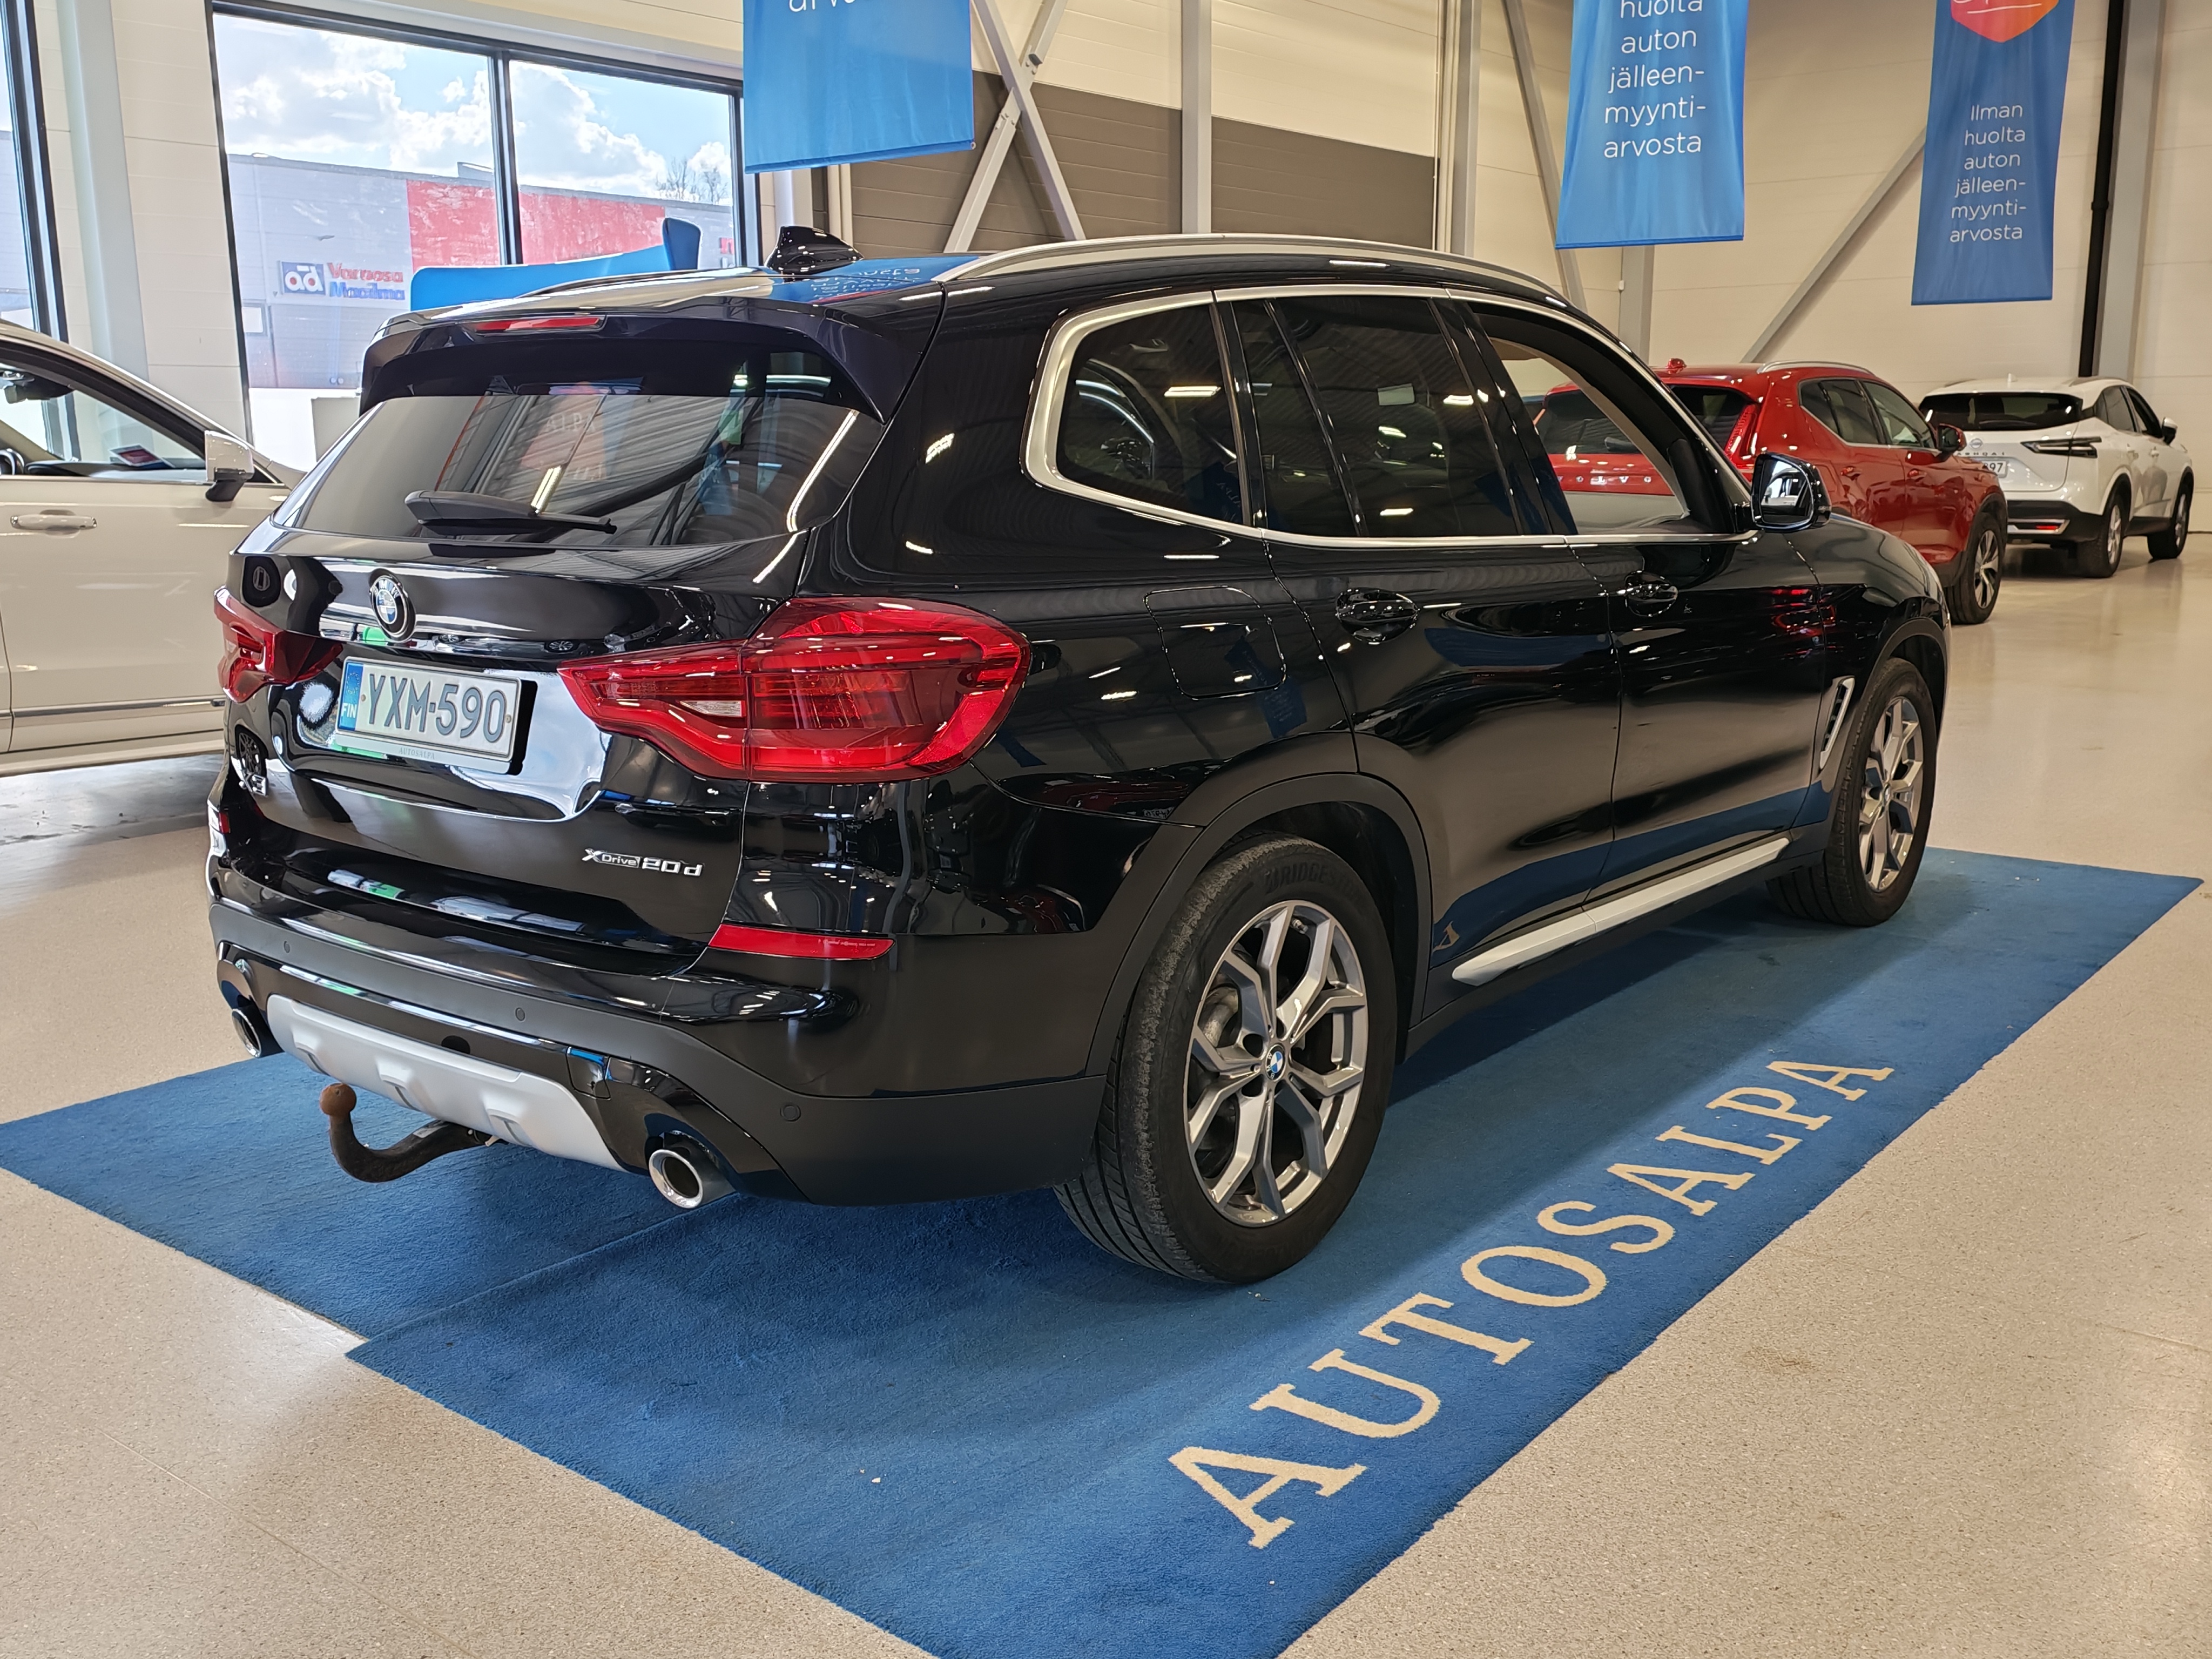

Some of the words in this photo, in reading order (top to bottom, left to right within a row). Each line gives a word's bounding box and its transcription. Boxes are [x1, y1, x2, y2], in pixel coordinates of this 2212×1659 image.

[1621, 29, 1697, 53] auton
[1608, 64, 1705, 93] jälleen-
[1605, 95, 1706, 127] myynti-
[1971, 105, 2022, 121] Ilman
[1604, 132, 1702, 158] arvosta
[1964, 127, 2025, 146] huolta
[1964, 153, 2020, 170] auton
[1954, 177, 2026, 198] jälleen-
[1951, 199, 2027, 221] myynti-
[1950, 224, 2023, 242] arvosta
[341, 703, 357, 719] FIN
[368, 673, 507, 743] YXM-590
[400, 746, 435, 760] AUTOSALPA
[1168, 1059, 1896, 1550] AUTOSALPA
